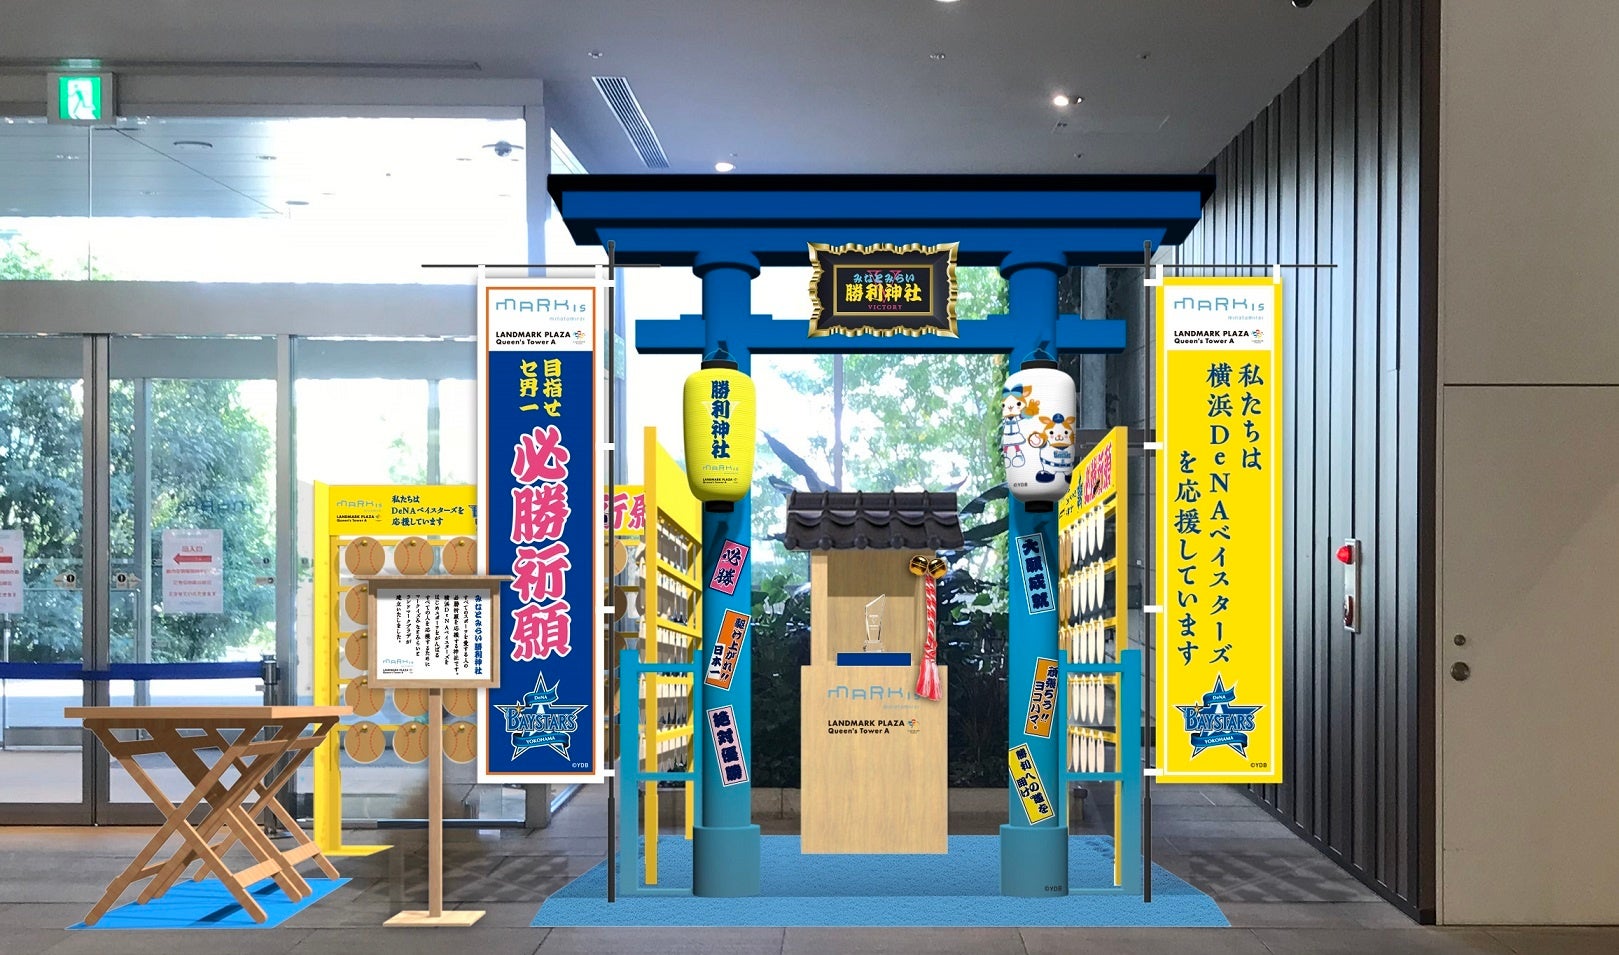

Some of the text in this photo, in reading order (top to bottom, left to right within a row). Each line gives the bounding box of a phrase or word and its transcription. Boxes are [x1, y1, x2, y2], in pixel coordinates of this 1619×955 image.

[845, 283, 923, 302] 勝利神社
[853, 273, 915, 284] みなとみらい
[496, 298, 569, 312] MARK
[1174, 297, 1248, 312] MARK
[543, 358, 562, 417] 目指せ
[711, 380, 730, 459] 勝利神社
[1238, 362, 1264, 470] 私たちは
[391, 506, 464, 514] DeNAベイスターズを
[392, 494, 420, 504] 私たちは
[1206, 362, 1234, 664] 横浜DeNAベイスターズ
[392, 517, 444, 526] 応援しています
[510, 424, 572, 662] 必勝祈願
[1174, 450, 1202, 666] を応援しています
[714, 547, 742, 587] 必勝
[1022, 538, 1050, 610] 大願成就
[474, 594, 482, 675] みなとみらい勝利神社
[710, 644, 724, 675] 日本一
[828, 686, 904, 700] MARK
[526, 736, 556, 744] YOKOHAMA
[712, 710, 742, 782] 絶対優勝
[1204, 736, 1234, 744] YOKOHAMA
[1016, 748, 1048, 815] 勝利への道を
